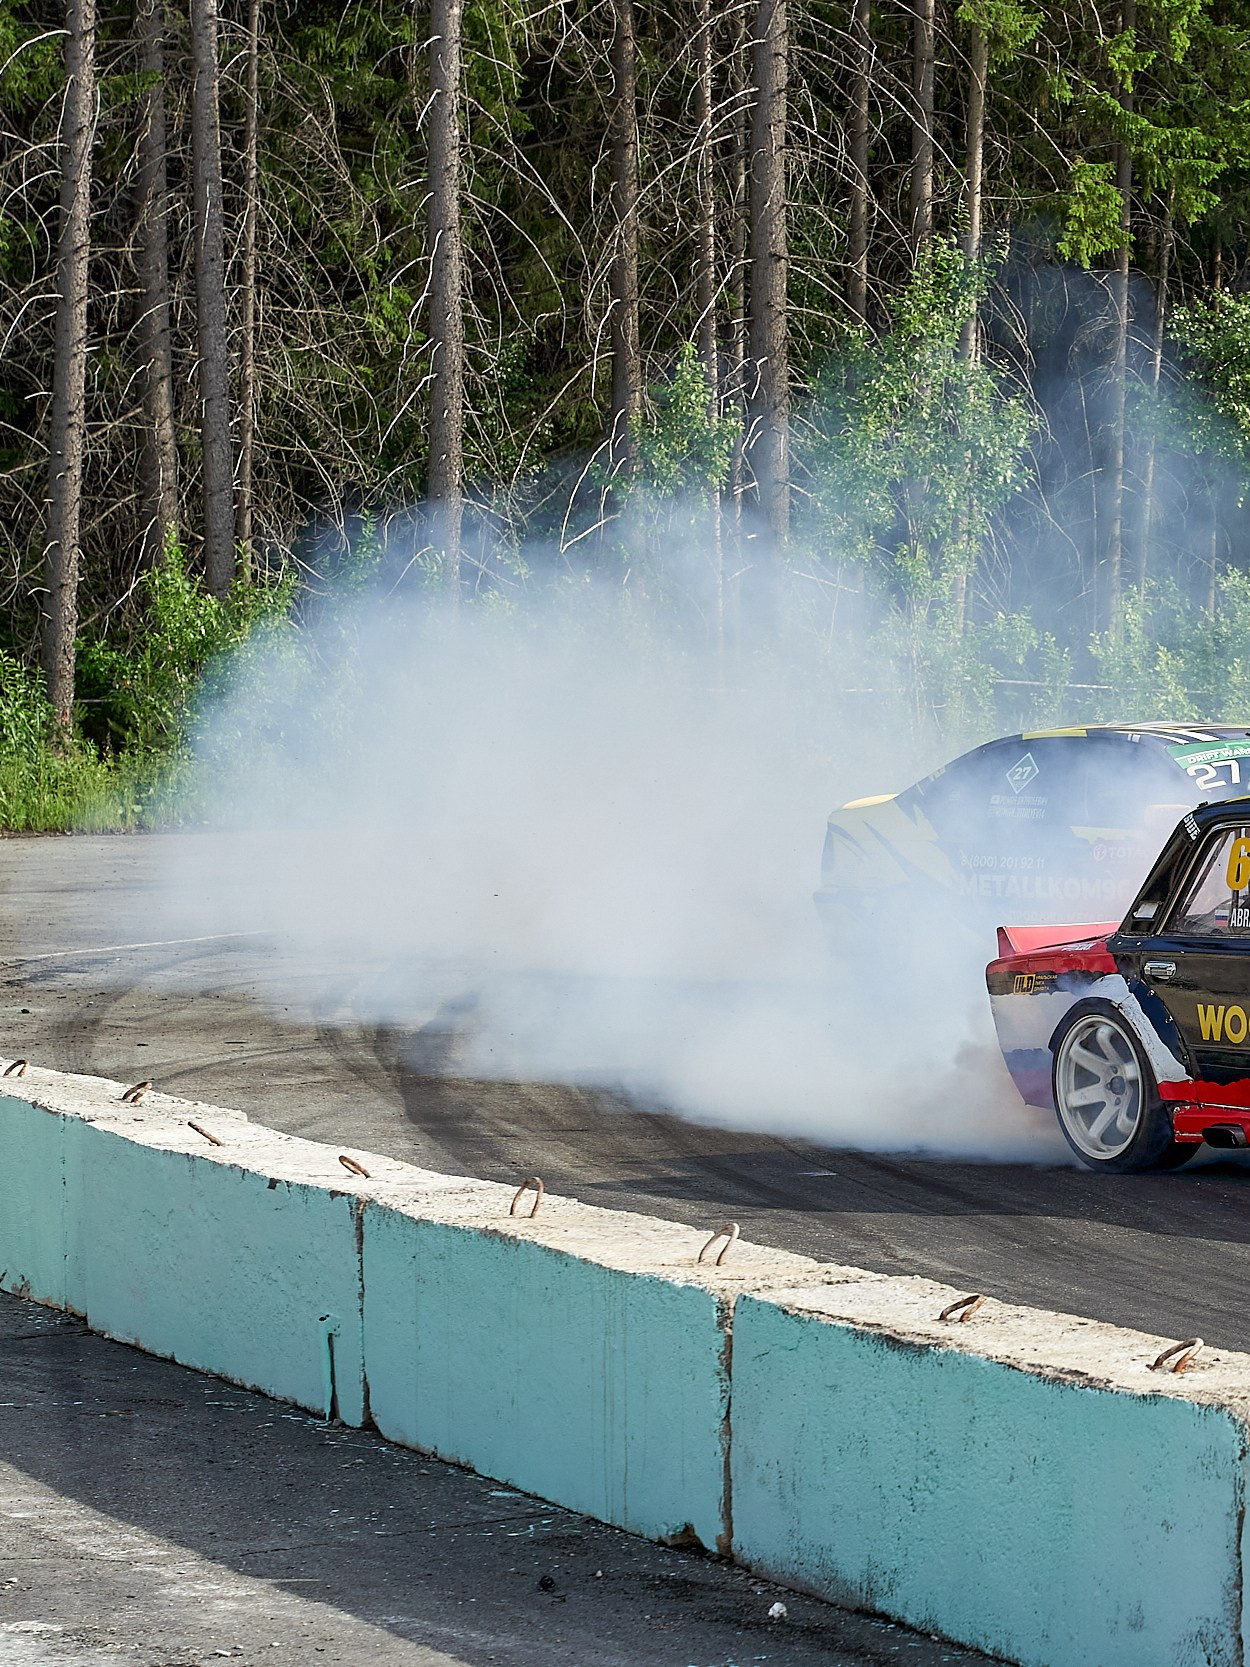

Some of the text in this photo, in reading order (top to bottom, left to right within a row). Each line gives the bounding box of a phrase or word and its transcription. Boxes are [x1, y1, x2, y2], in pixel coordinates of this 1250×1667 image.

[1187, 752, 1219, 763] DRIFT
[1012, 766, 1032, 780] 27
[1186, 759, 1241, 791] 27
